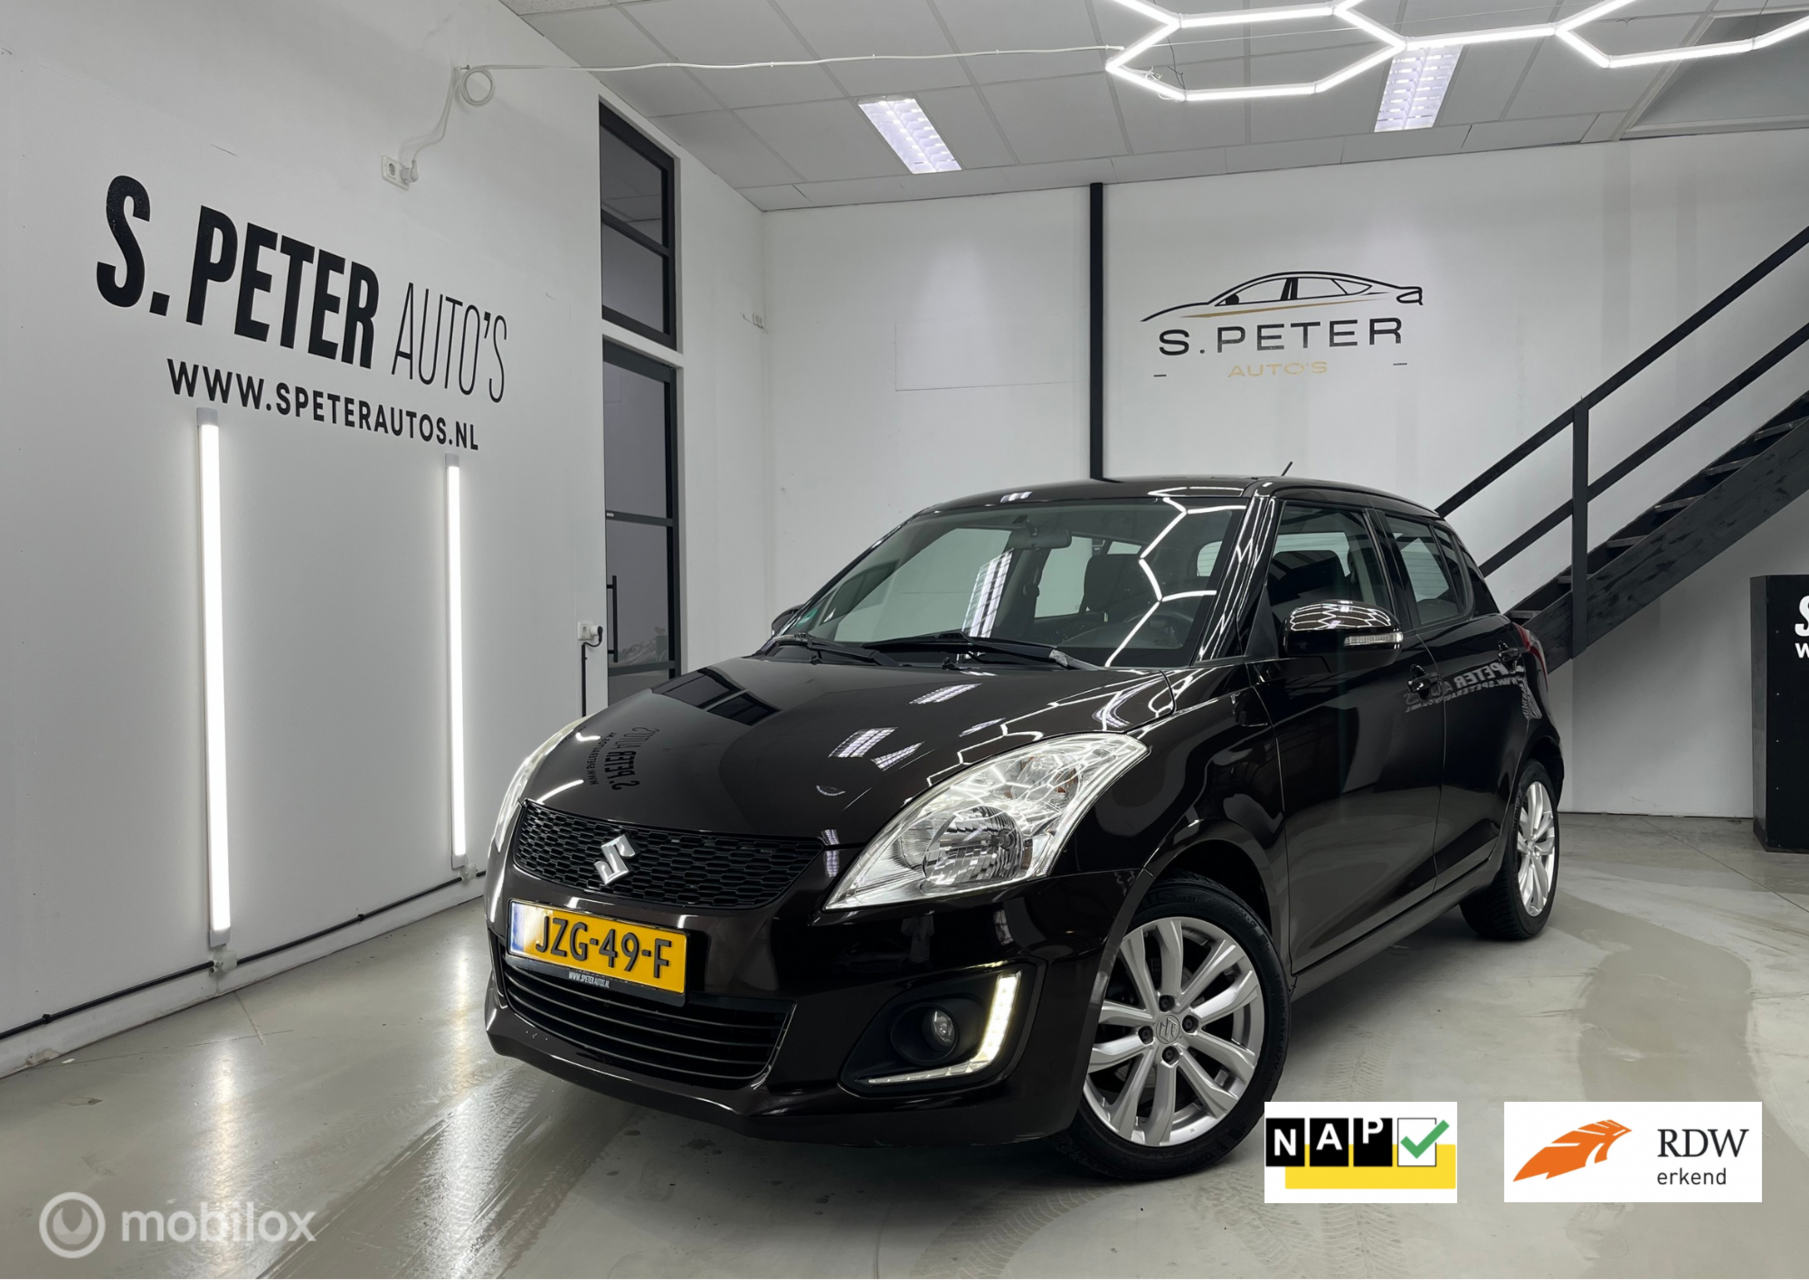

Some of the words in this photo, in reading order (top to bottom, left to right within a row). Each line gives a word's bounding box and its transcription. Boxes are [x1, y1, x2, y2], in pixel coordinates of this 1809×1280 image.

[186, 206, 380, 370] PETER
[391, 282, 507, 403] AUTO'S
[167, 358, 479, 451] WWW.SPETERAUTOS.NL
[1228, 361, 1328, 377] AUTO'S
[535, 915, 673, 980] JZG-49-F
